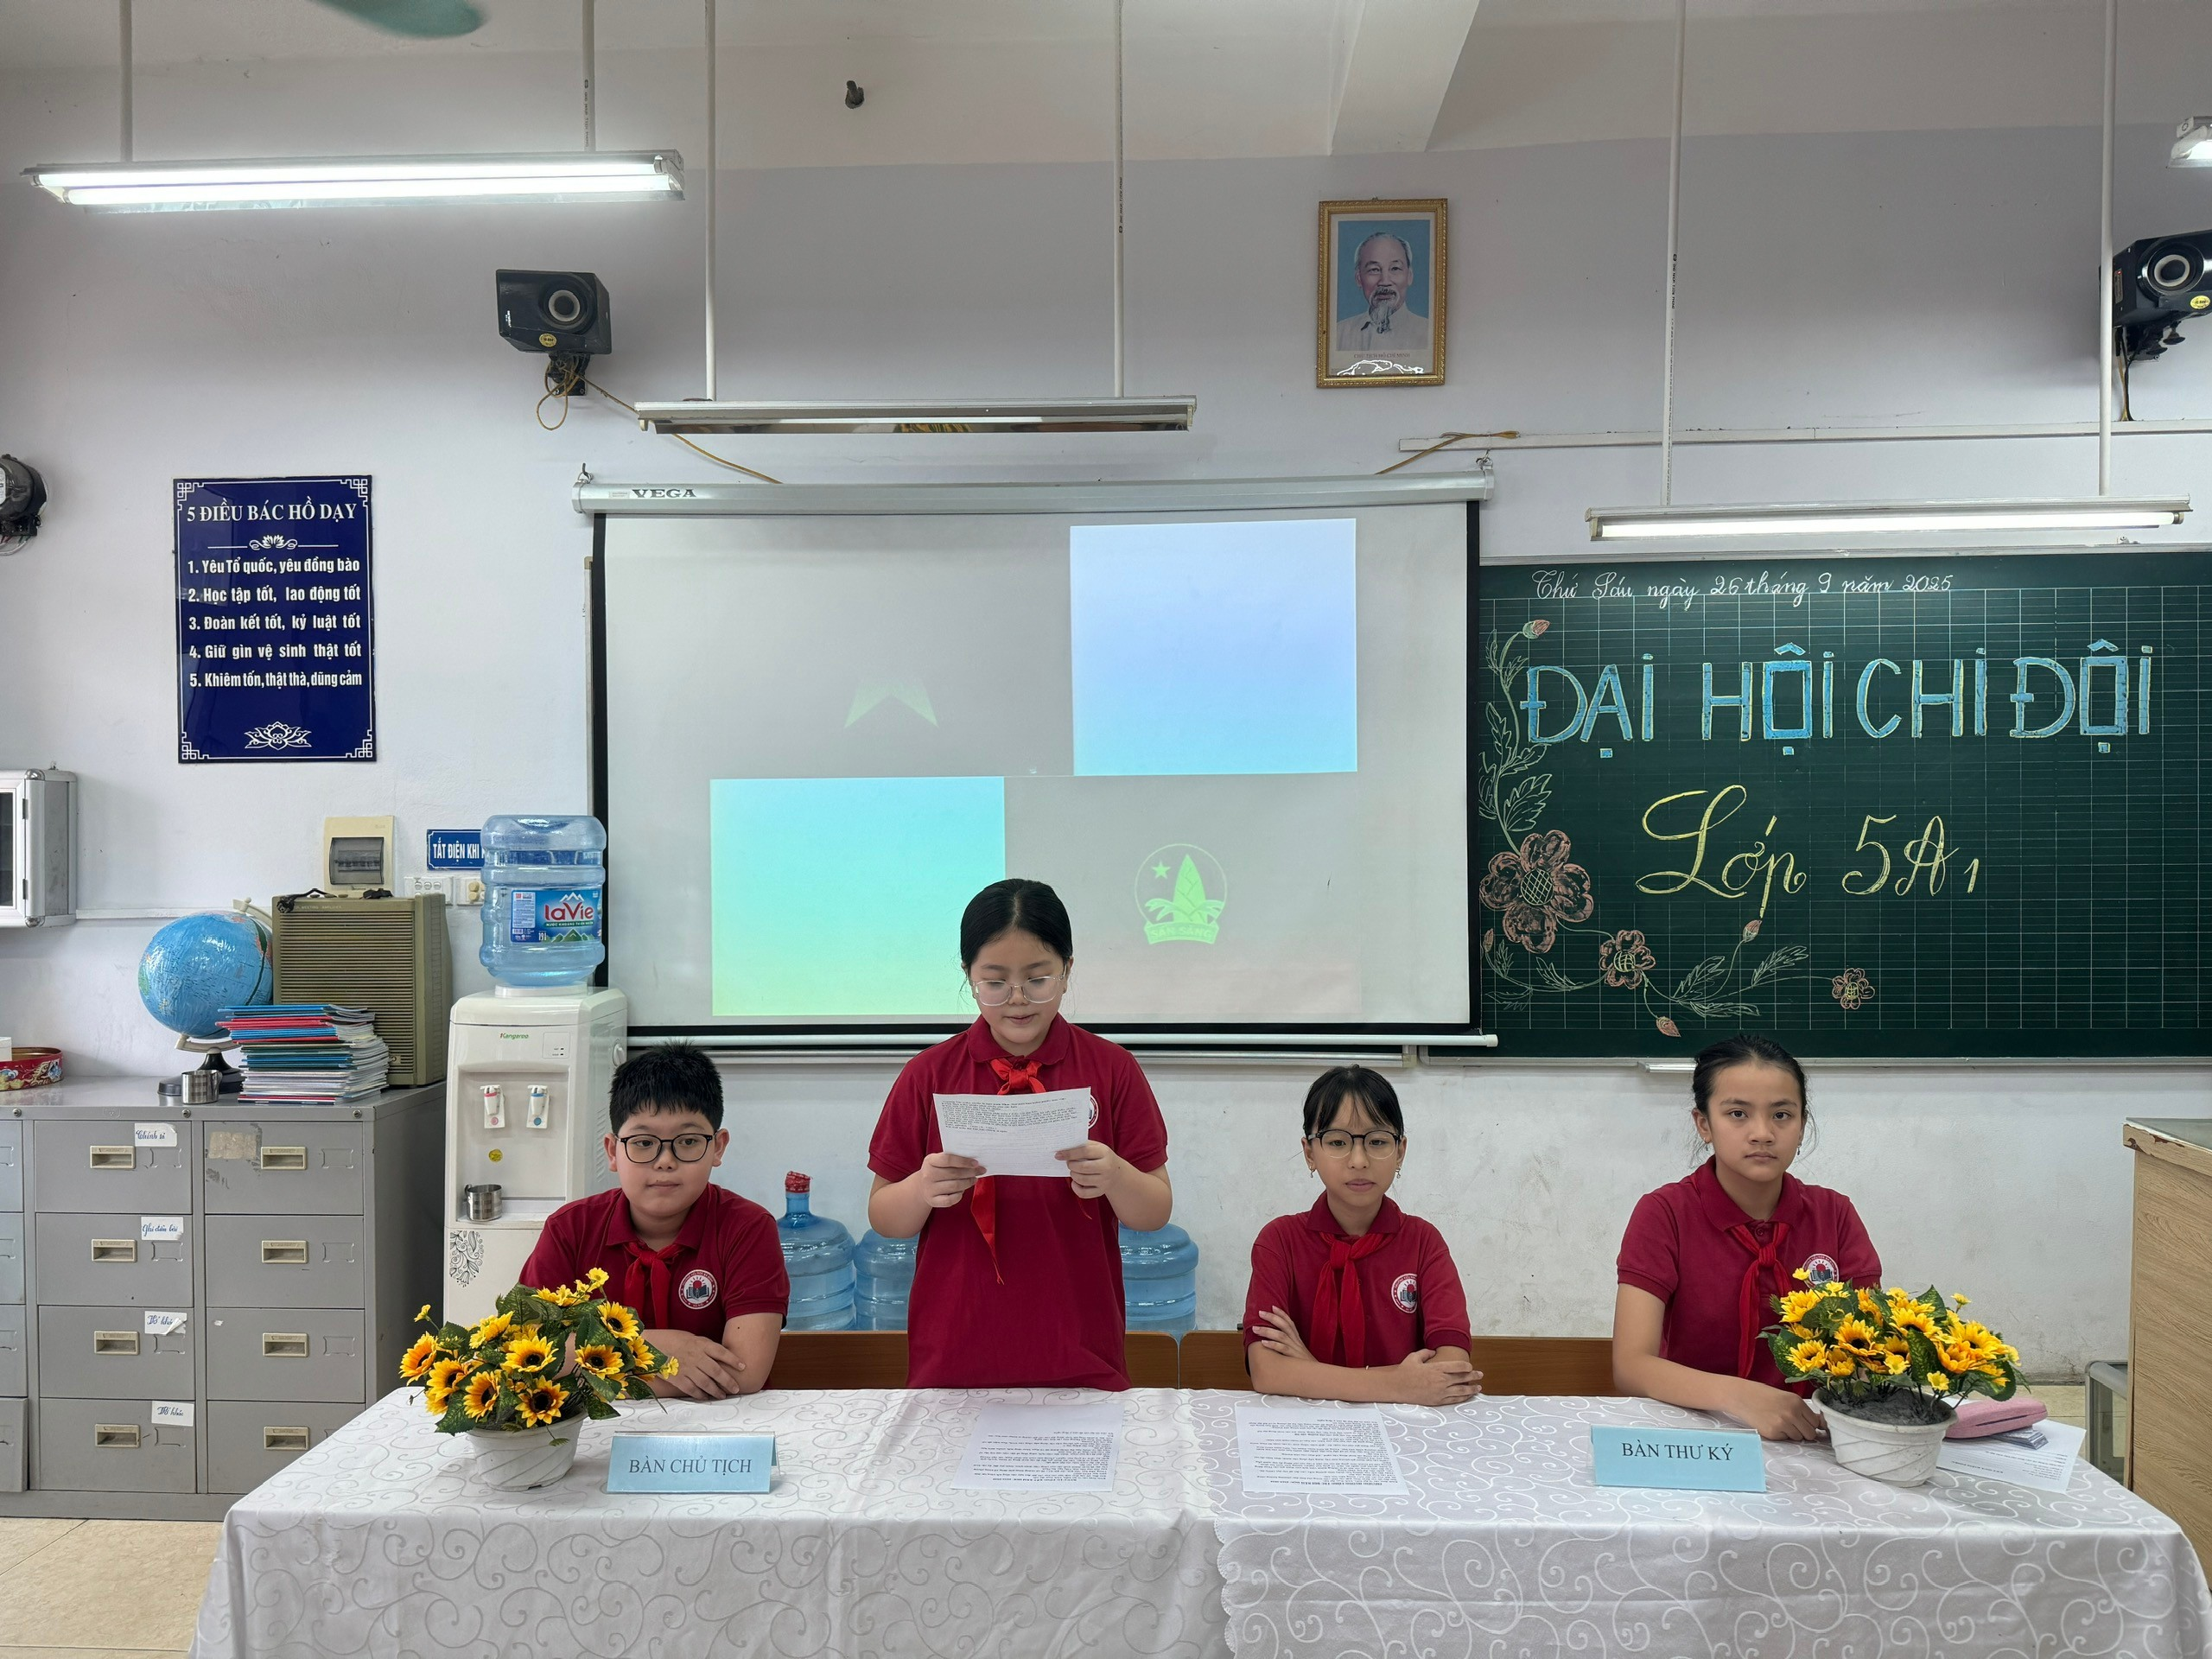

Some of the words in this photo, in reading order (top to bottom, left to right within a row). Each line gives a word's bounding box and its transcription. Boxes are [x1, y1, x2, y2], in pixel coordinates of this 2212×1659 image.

[632, 488, 696, 499] VEGA
[187, 506, 195, 522] 5
[200, 498, 243, 522] ĐIỀU
[247, 499, 284, 521] BÁC
[289, 496, 315, 520] HỒ
[320, 503, 357, 523] DẠY
[188, 562, 199, 574] 1.
[202, 559, 224, 574] Yêu
[226, 556, 241, 573] Tổ
[243, 556, 277, 575] quốc,
[279, 558, 302, 575] yêu
[303, 556, 334, 574] đồng
[337, 557, 360, 572] bào
[188, 588, 200, 602] 2.
[203, 588, 227, 605] Học
[231, 587, 251, 605] tập
[257, 585, 277, 603] tốt,
[286, 587, 305, 601] lao
[309, 586, 340, 603] động
[344, 583, 361, 601] tốt
[1531, 569, 1579, 599] Thứ
[1592, 571, 1634, 600] Sáu
[1647, 577, 1700, 611] ngày
[1710, 575, 1742, 594] 26
[1744, 570, 1809, 607] tháng
[1818, 572, 1832, 594] 9
[1841, 575, 1895, 593] năm
[1903, 574, 1954, 592] 2025
[188, 616, 200, 630] 3.
[204, 616, 236, 630] Đoàn
[240, 613, 260, 630] kết
[264, 613, 285, 631] tốt,
[292, 613, 307, 631] kỷ
[313, 614, 337, 632] luật
[342, 612, 361, 629] tốt
[189, 645, 201, 658] 4.
[205, 644, 226, 658] Giữ
[232, 644, 252, 660] gìn
[257, 644, 272, 660] vệ
[279, 643, 306, 658] sinh
[313, 643, 339, 660] thật
[344, 640, 362, 658] tốt
[189, 674, 201, 688] 5.
[205, 671, 241, 688] Khiêm
[243, 670, 264, 689] tốn,
[265, 671, 288, 690] thật
[289, 671, 309, 688] thà,
[310, 671, 338, 688] dũng
[340, 670, 362, 686] cảm
[433, 837, 447, 859] TẮT
[448, 840, 466, 862] ĐIỆN
[467, 843, 480, 859] KHI
[1635, 784, 1807, 918] Lớp
[1621, 1439, 1660, 1458] BÀN
[1664, 1444, 1704, 1459] THƯ
[1708, 1442, 1734, 1461] KÝ
[628, 1455, 667, 1473] BÀN
[670, 1455, 709, 1473] CHỦ
[712, 1459, 753, 1476] TỊCH
